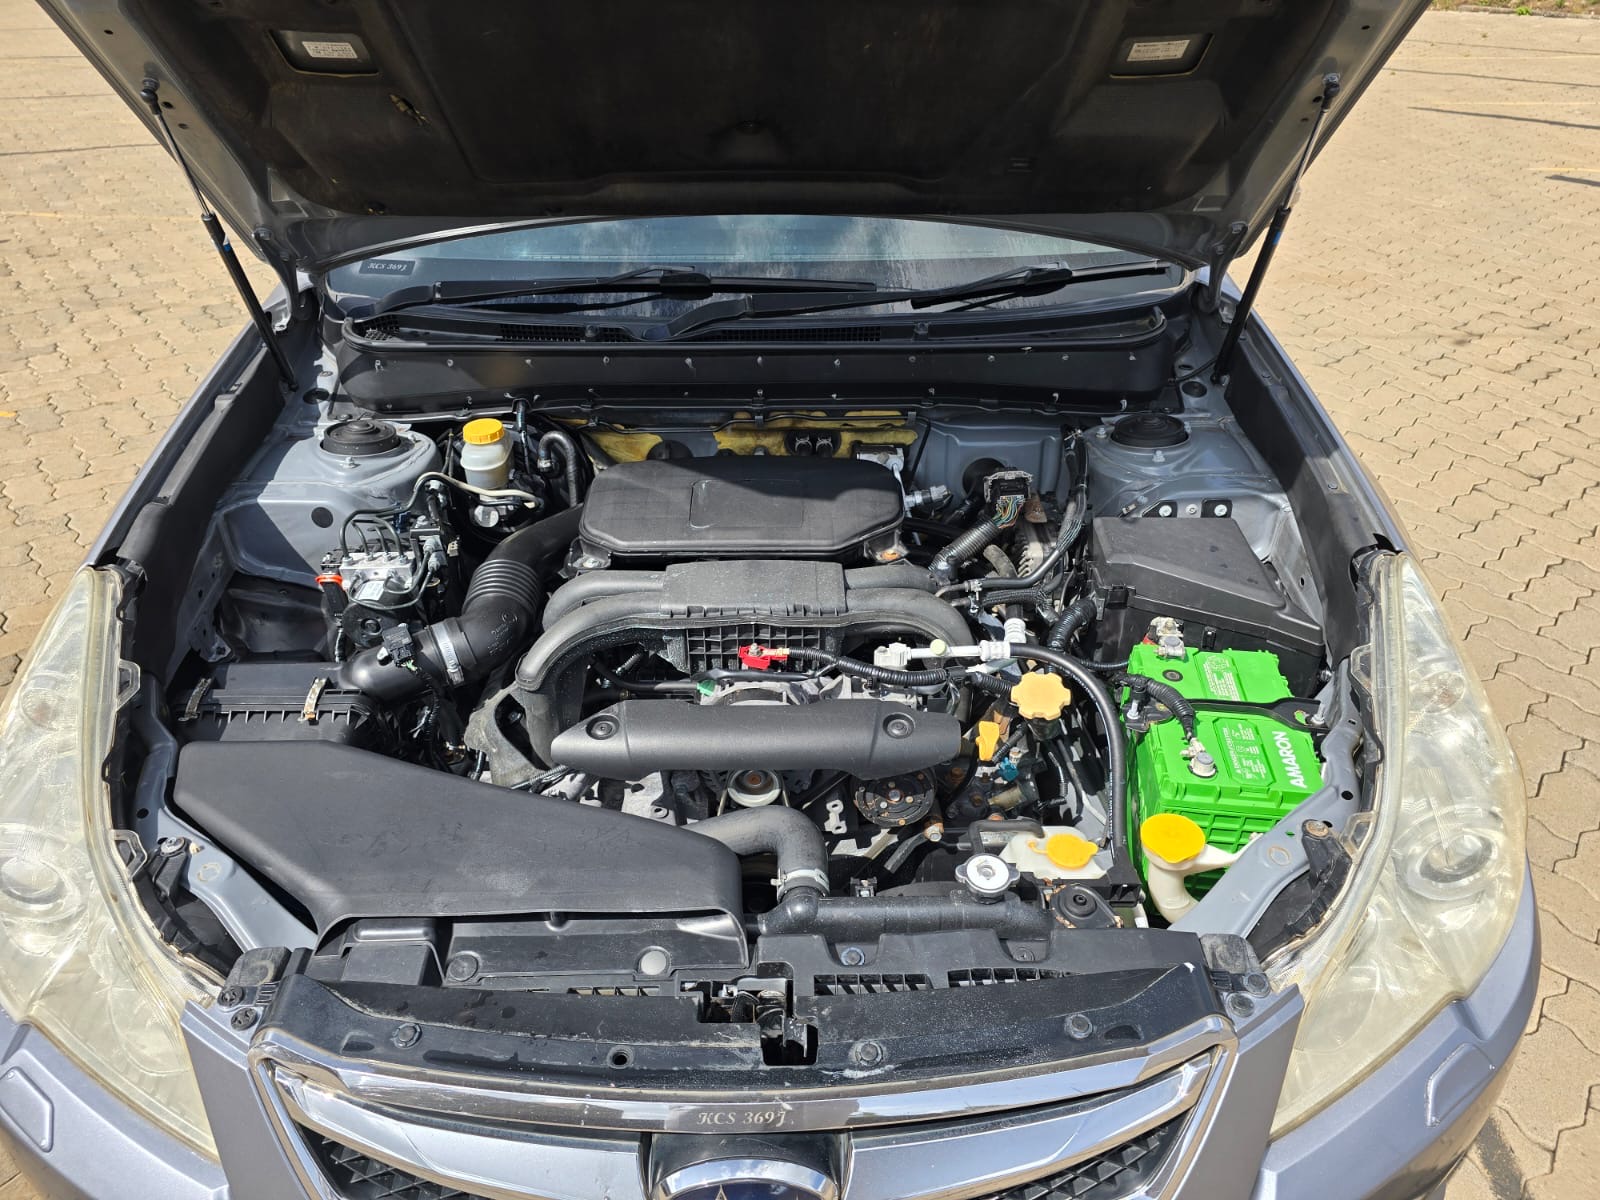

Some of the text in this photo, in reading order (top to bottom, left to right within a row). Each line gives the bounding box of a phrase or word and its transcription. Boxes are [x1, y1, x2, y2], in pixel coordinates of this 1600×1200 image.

[1272, 730, 1308, 788] AMARON
[696, 1111, 786, 1127] KCS 369J
